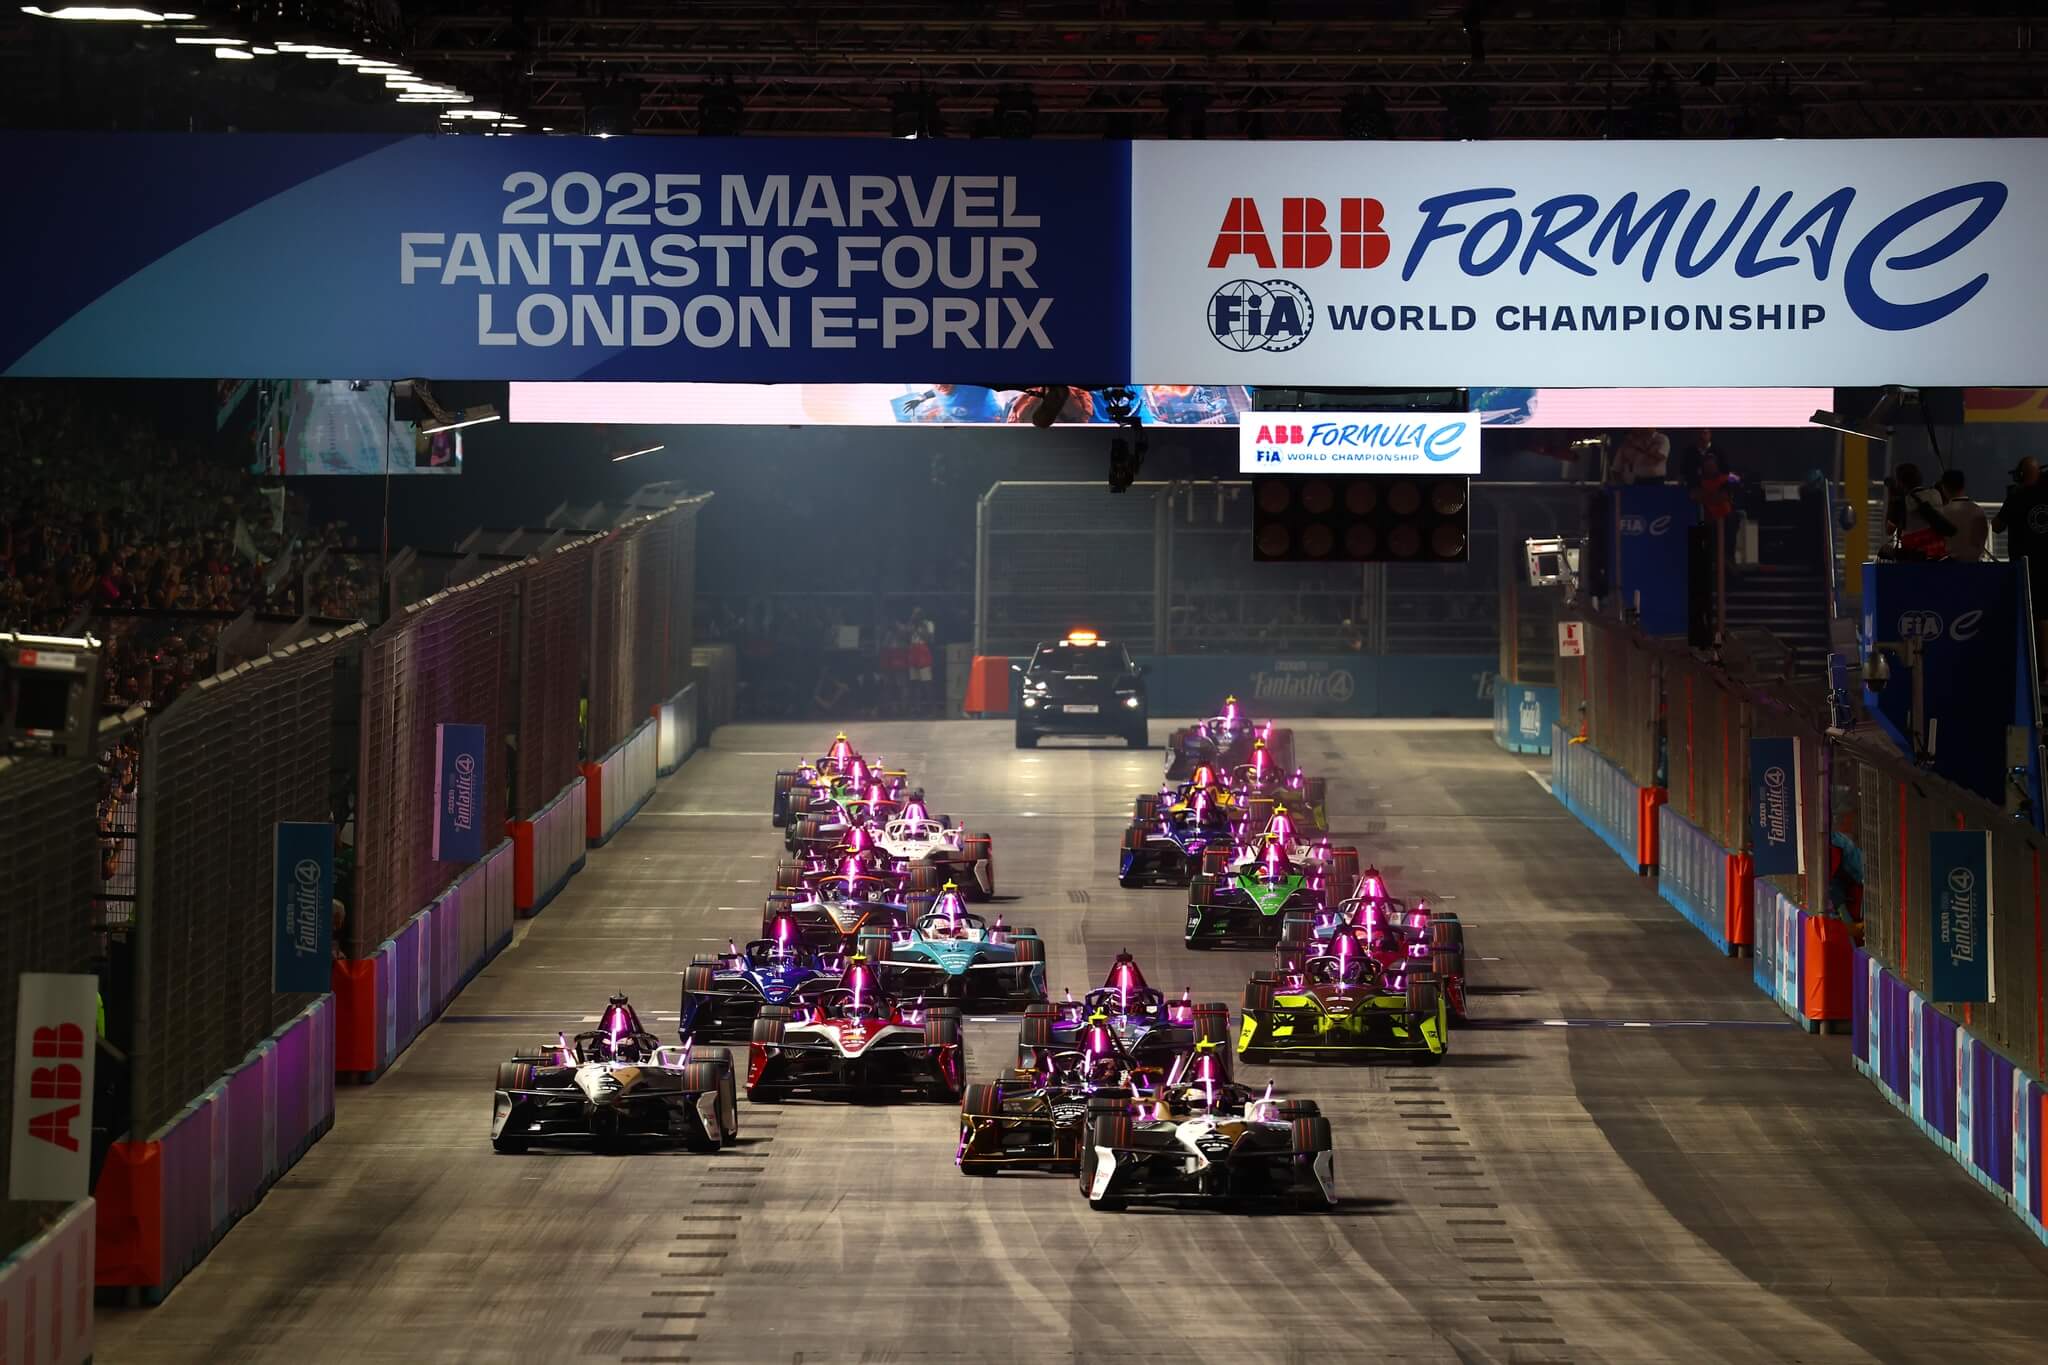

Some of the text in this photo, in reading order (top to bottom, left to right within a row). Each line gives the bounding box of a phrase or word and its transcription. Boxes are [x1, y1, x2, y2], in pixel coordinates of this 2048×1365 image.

[502, 171, 1041, 228] 2025 MARVEL
[400, 232, 1039, 289] FANTASTIC FOUR
[1207, 197, 1391, 269] ABB
[1401, 186, 1856, 283] FORMULA
[478, 293, 1054, 349] LONDON E-PRIX
[1328, 304, 1826, 331] WORLD CHAMPIONSHIP
[1256, 425, 1304, 444] ABB
[1307, 422, 1427, 447] FORMULA
[1287, 453, 1419, 462] WORLD CHAMPIONSHIP
[1254, 671, 1328, 699] Fantastic
[454, 774, 472, 829] Fantastic
[1767, 785, 1785, 842] Fantastic
[295, 883, 318, 952] Fantastic
[1951, 892, 1974, 962] Fantastic
[28, 1022, 84, 1153] ABB
